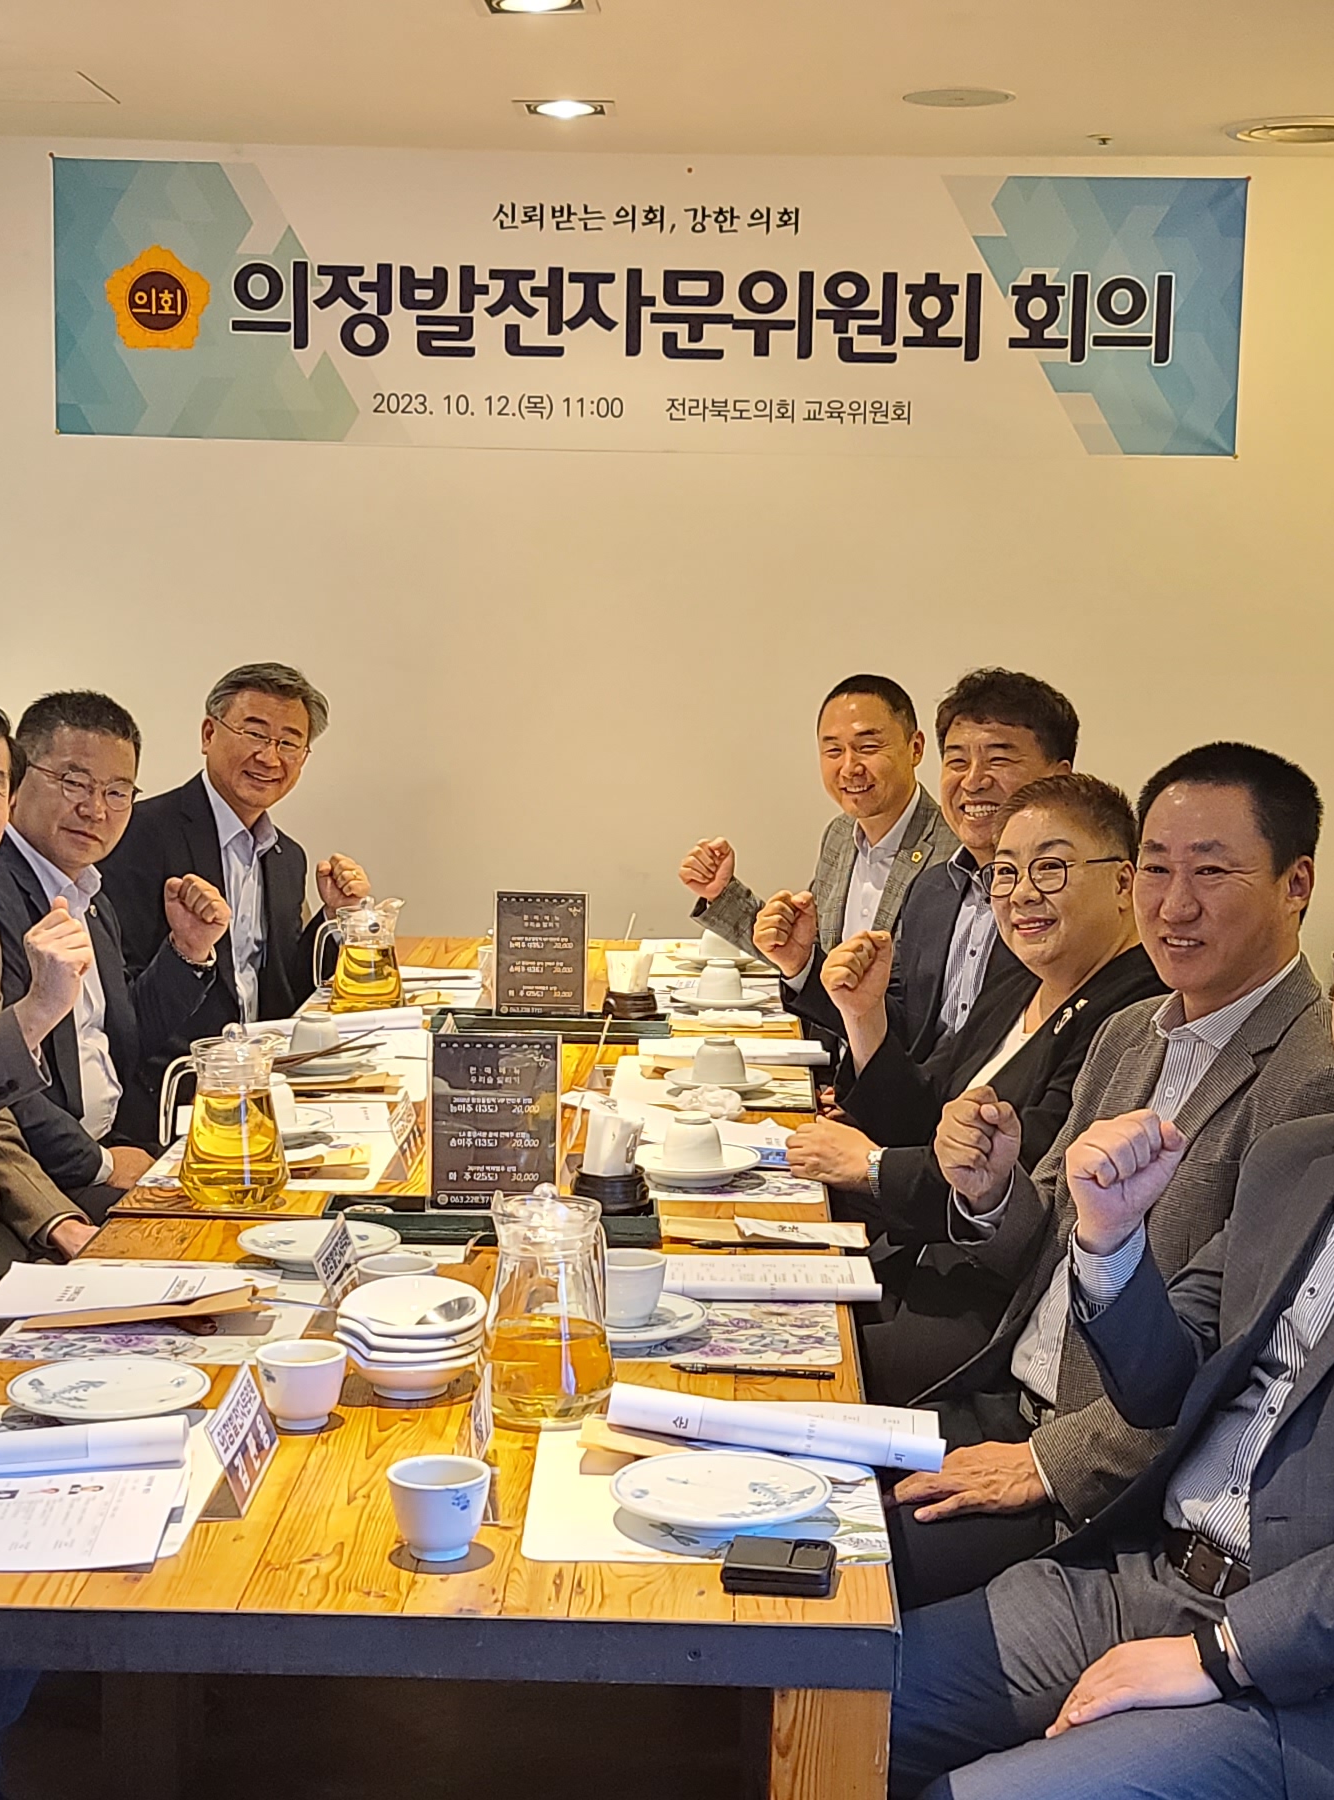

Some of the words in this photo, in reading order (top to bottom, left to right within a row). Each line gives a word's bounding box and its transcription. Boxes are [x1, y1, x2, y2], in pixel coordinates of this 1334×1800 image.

[492, 202, 606, 232] 신뢰받는
[613, 204, 676, 234] 의회,
[684, 205, 741, 234] 강한
[747, 206, 800, 236] 의회
[132, 287, 182, 316] 의회
[230, 261, 983, 365] 의정발전자문위원회
[1008, 272, 1174, 366] 회의
[372, 393, 434, 415] 2023.
[443, 394, 475, 416] 10.
[484, 394, 554, 420] 12.(목)
[562, 397, 624, 419] 11:00
[666, 397, 795, 424] 전라북도의회
[803, 399, 911, 426] 교육위원회
[511, 1105, 540, 1114] 20,000
[511, 1138, 540, 1148] 20,000
[511, 1173, 539, 1182] 30,000
